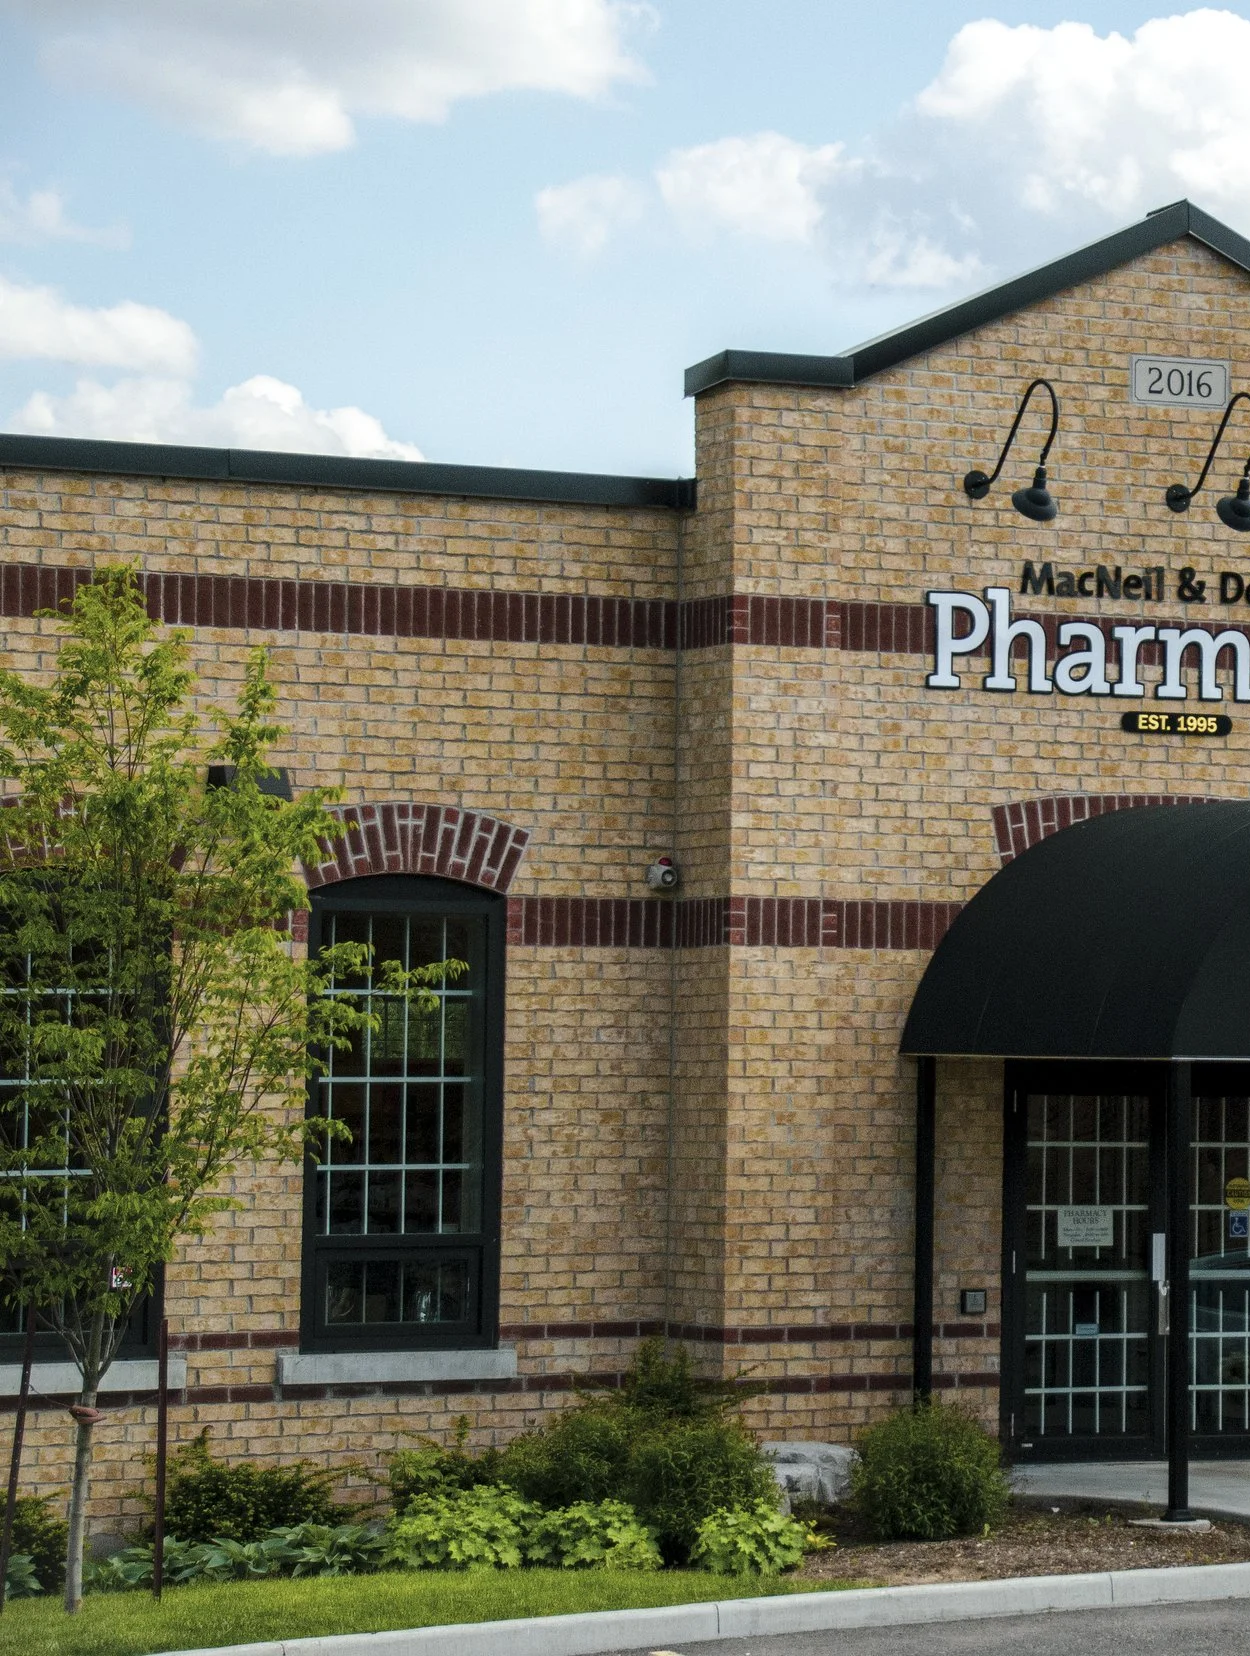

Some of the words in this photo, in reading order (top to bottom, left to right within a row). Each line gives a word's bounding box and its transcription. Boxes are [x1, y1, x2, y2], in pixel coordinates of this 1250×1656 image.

[1147, 367, 1213, 399] 2016
[1020, 560, 1164, 600] MacNeil
[1177, 567, 1206, 603] &
[1137, 714, 1172, 731] EST.
[1177, 716, 1217, 734] 1995
